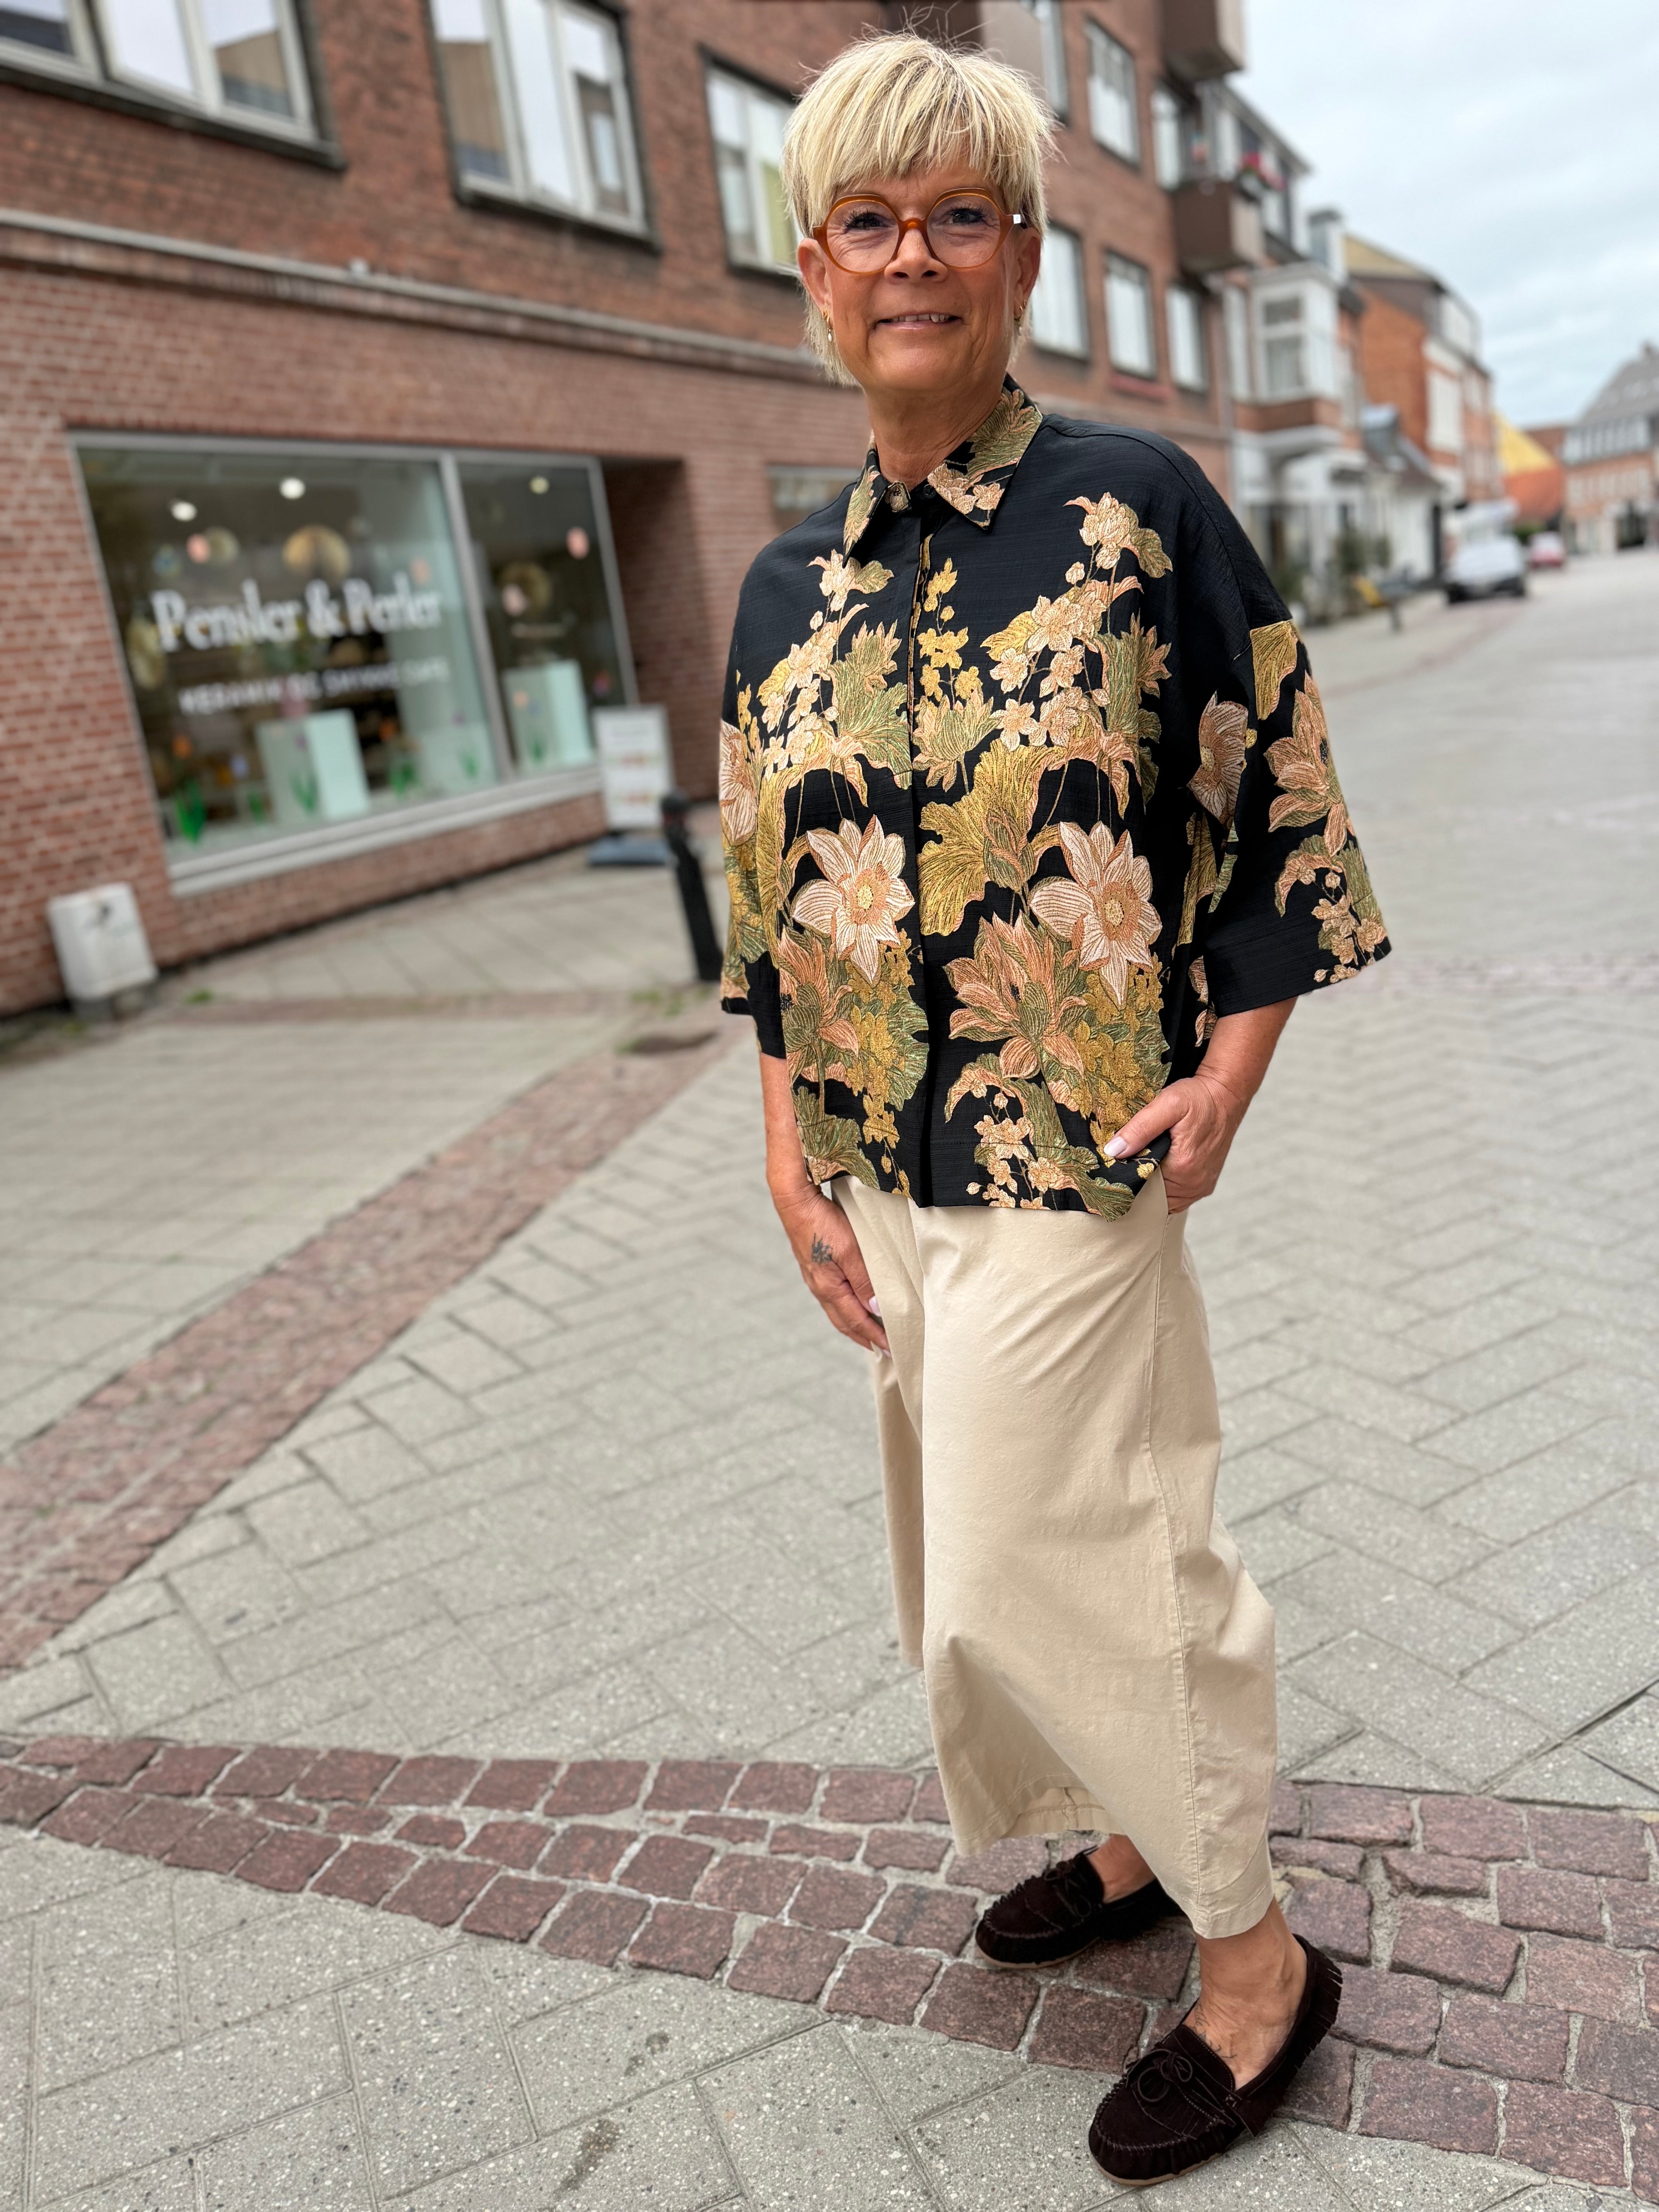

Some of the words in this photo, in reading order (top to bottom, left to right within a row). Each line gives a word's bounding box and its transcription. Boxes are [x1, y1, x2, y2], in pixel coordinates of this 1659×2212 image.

[151, 578, 301, 652] Pensler
[305, 579, 344, 639] &
[343, 571, 443, 634] Perler
